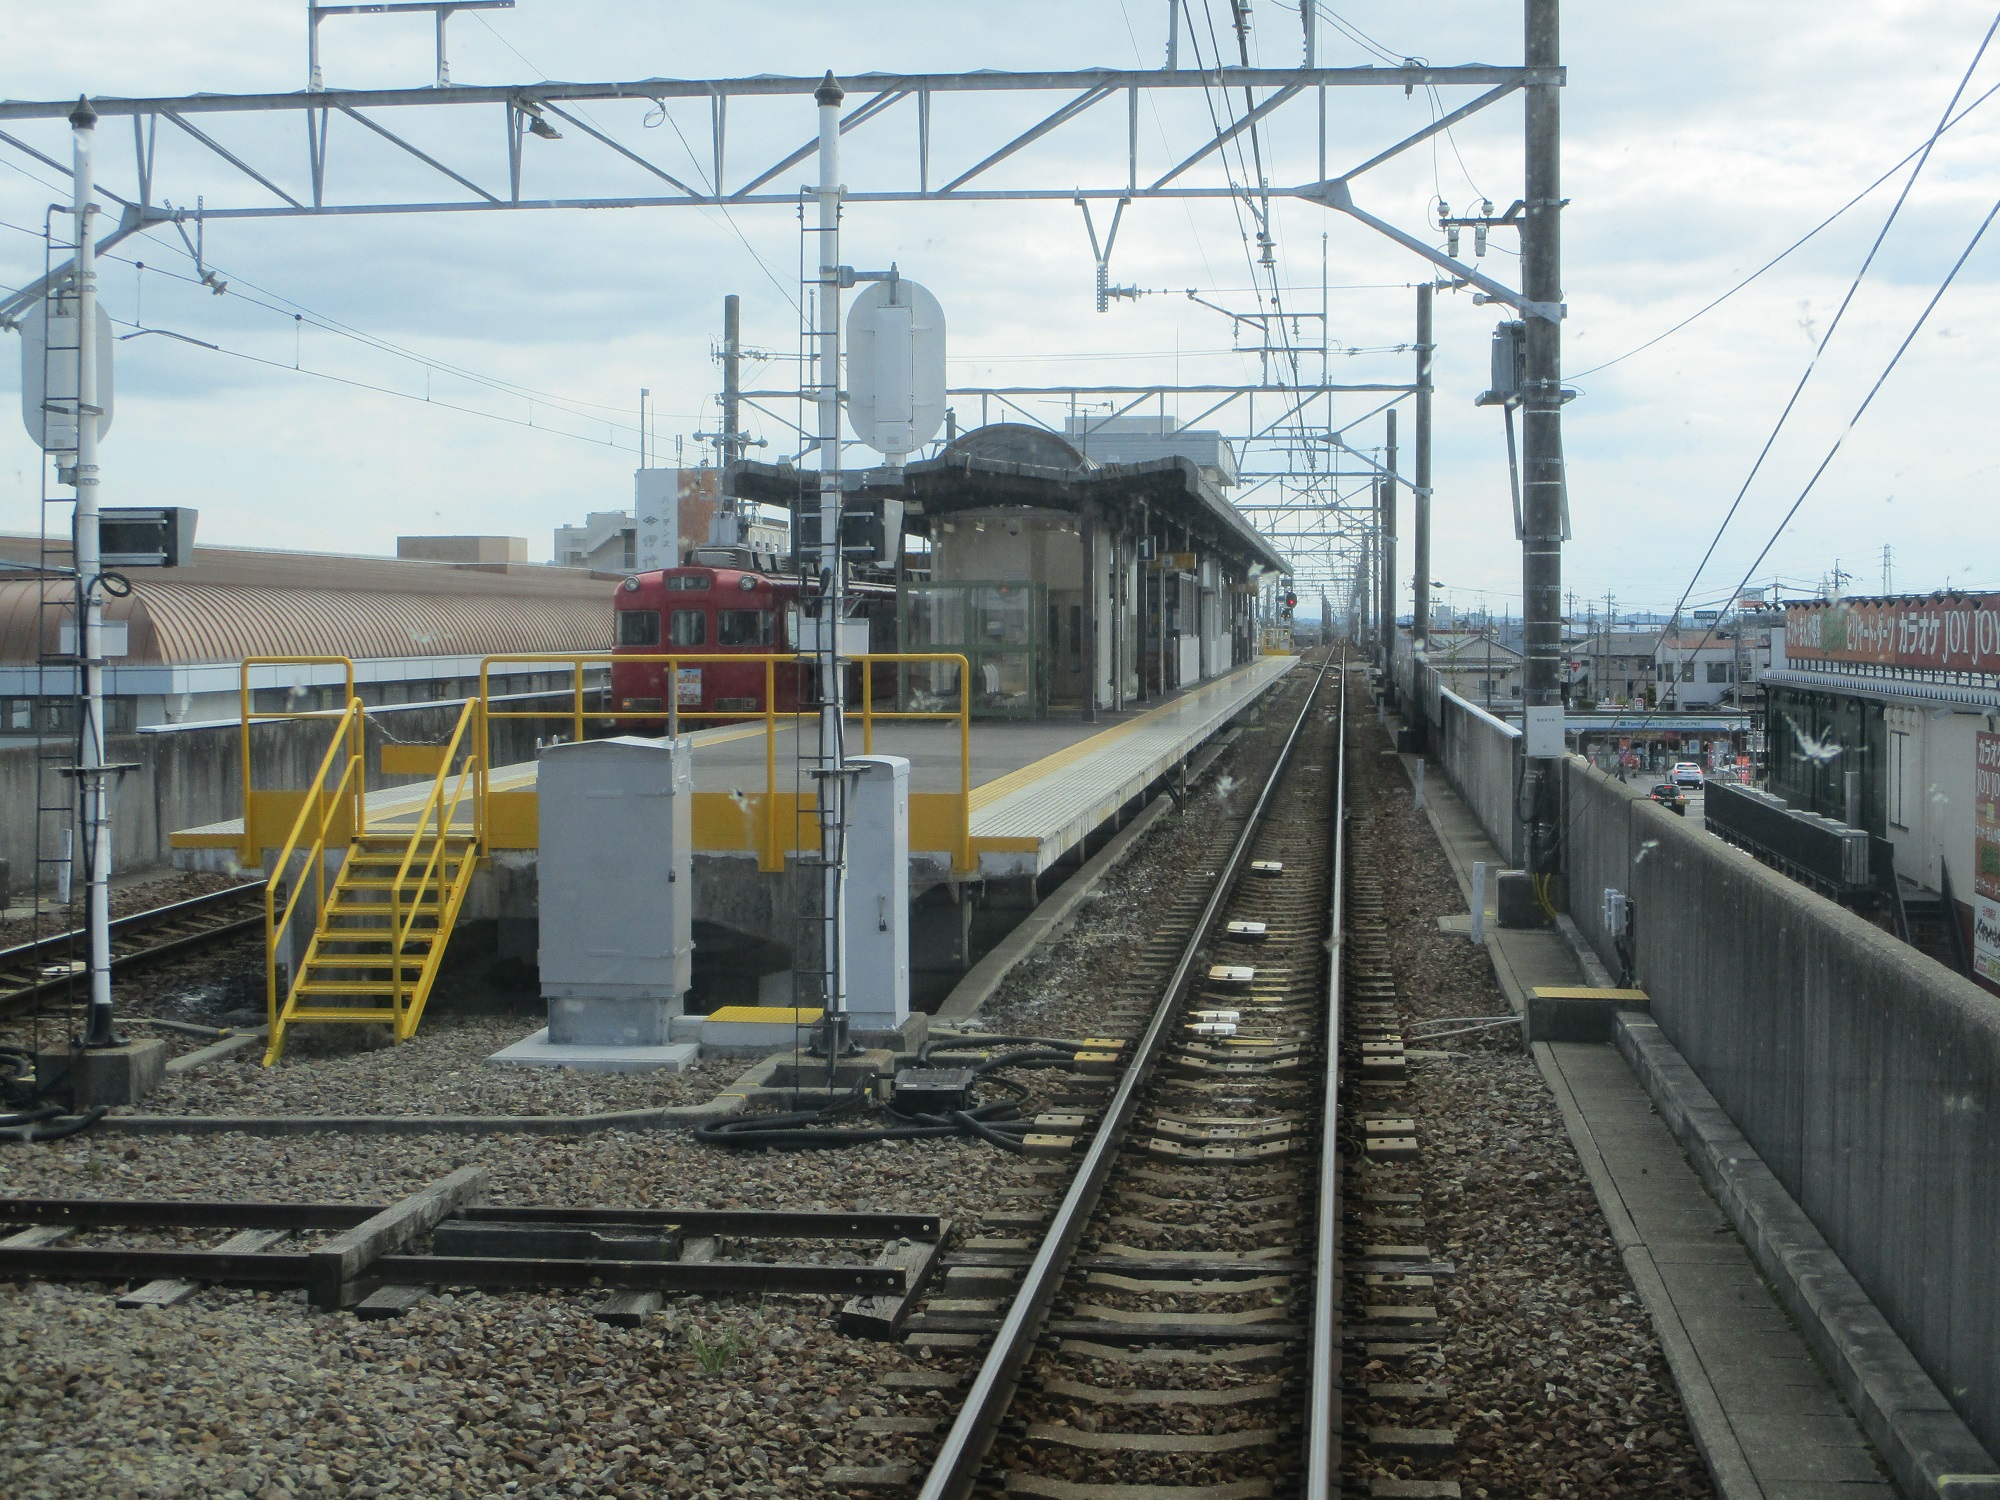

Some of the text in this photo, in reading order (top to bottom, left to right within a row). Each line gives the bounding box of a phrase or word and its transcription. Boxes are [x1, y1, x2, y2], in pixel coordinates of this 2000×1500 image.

[1140, 538, 1149, 557] 1
[1899, 610, 1940, 655] カラオケ
[1942, 610, 1970, 663] JOY
